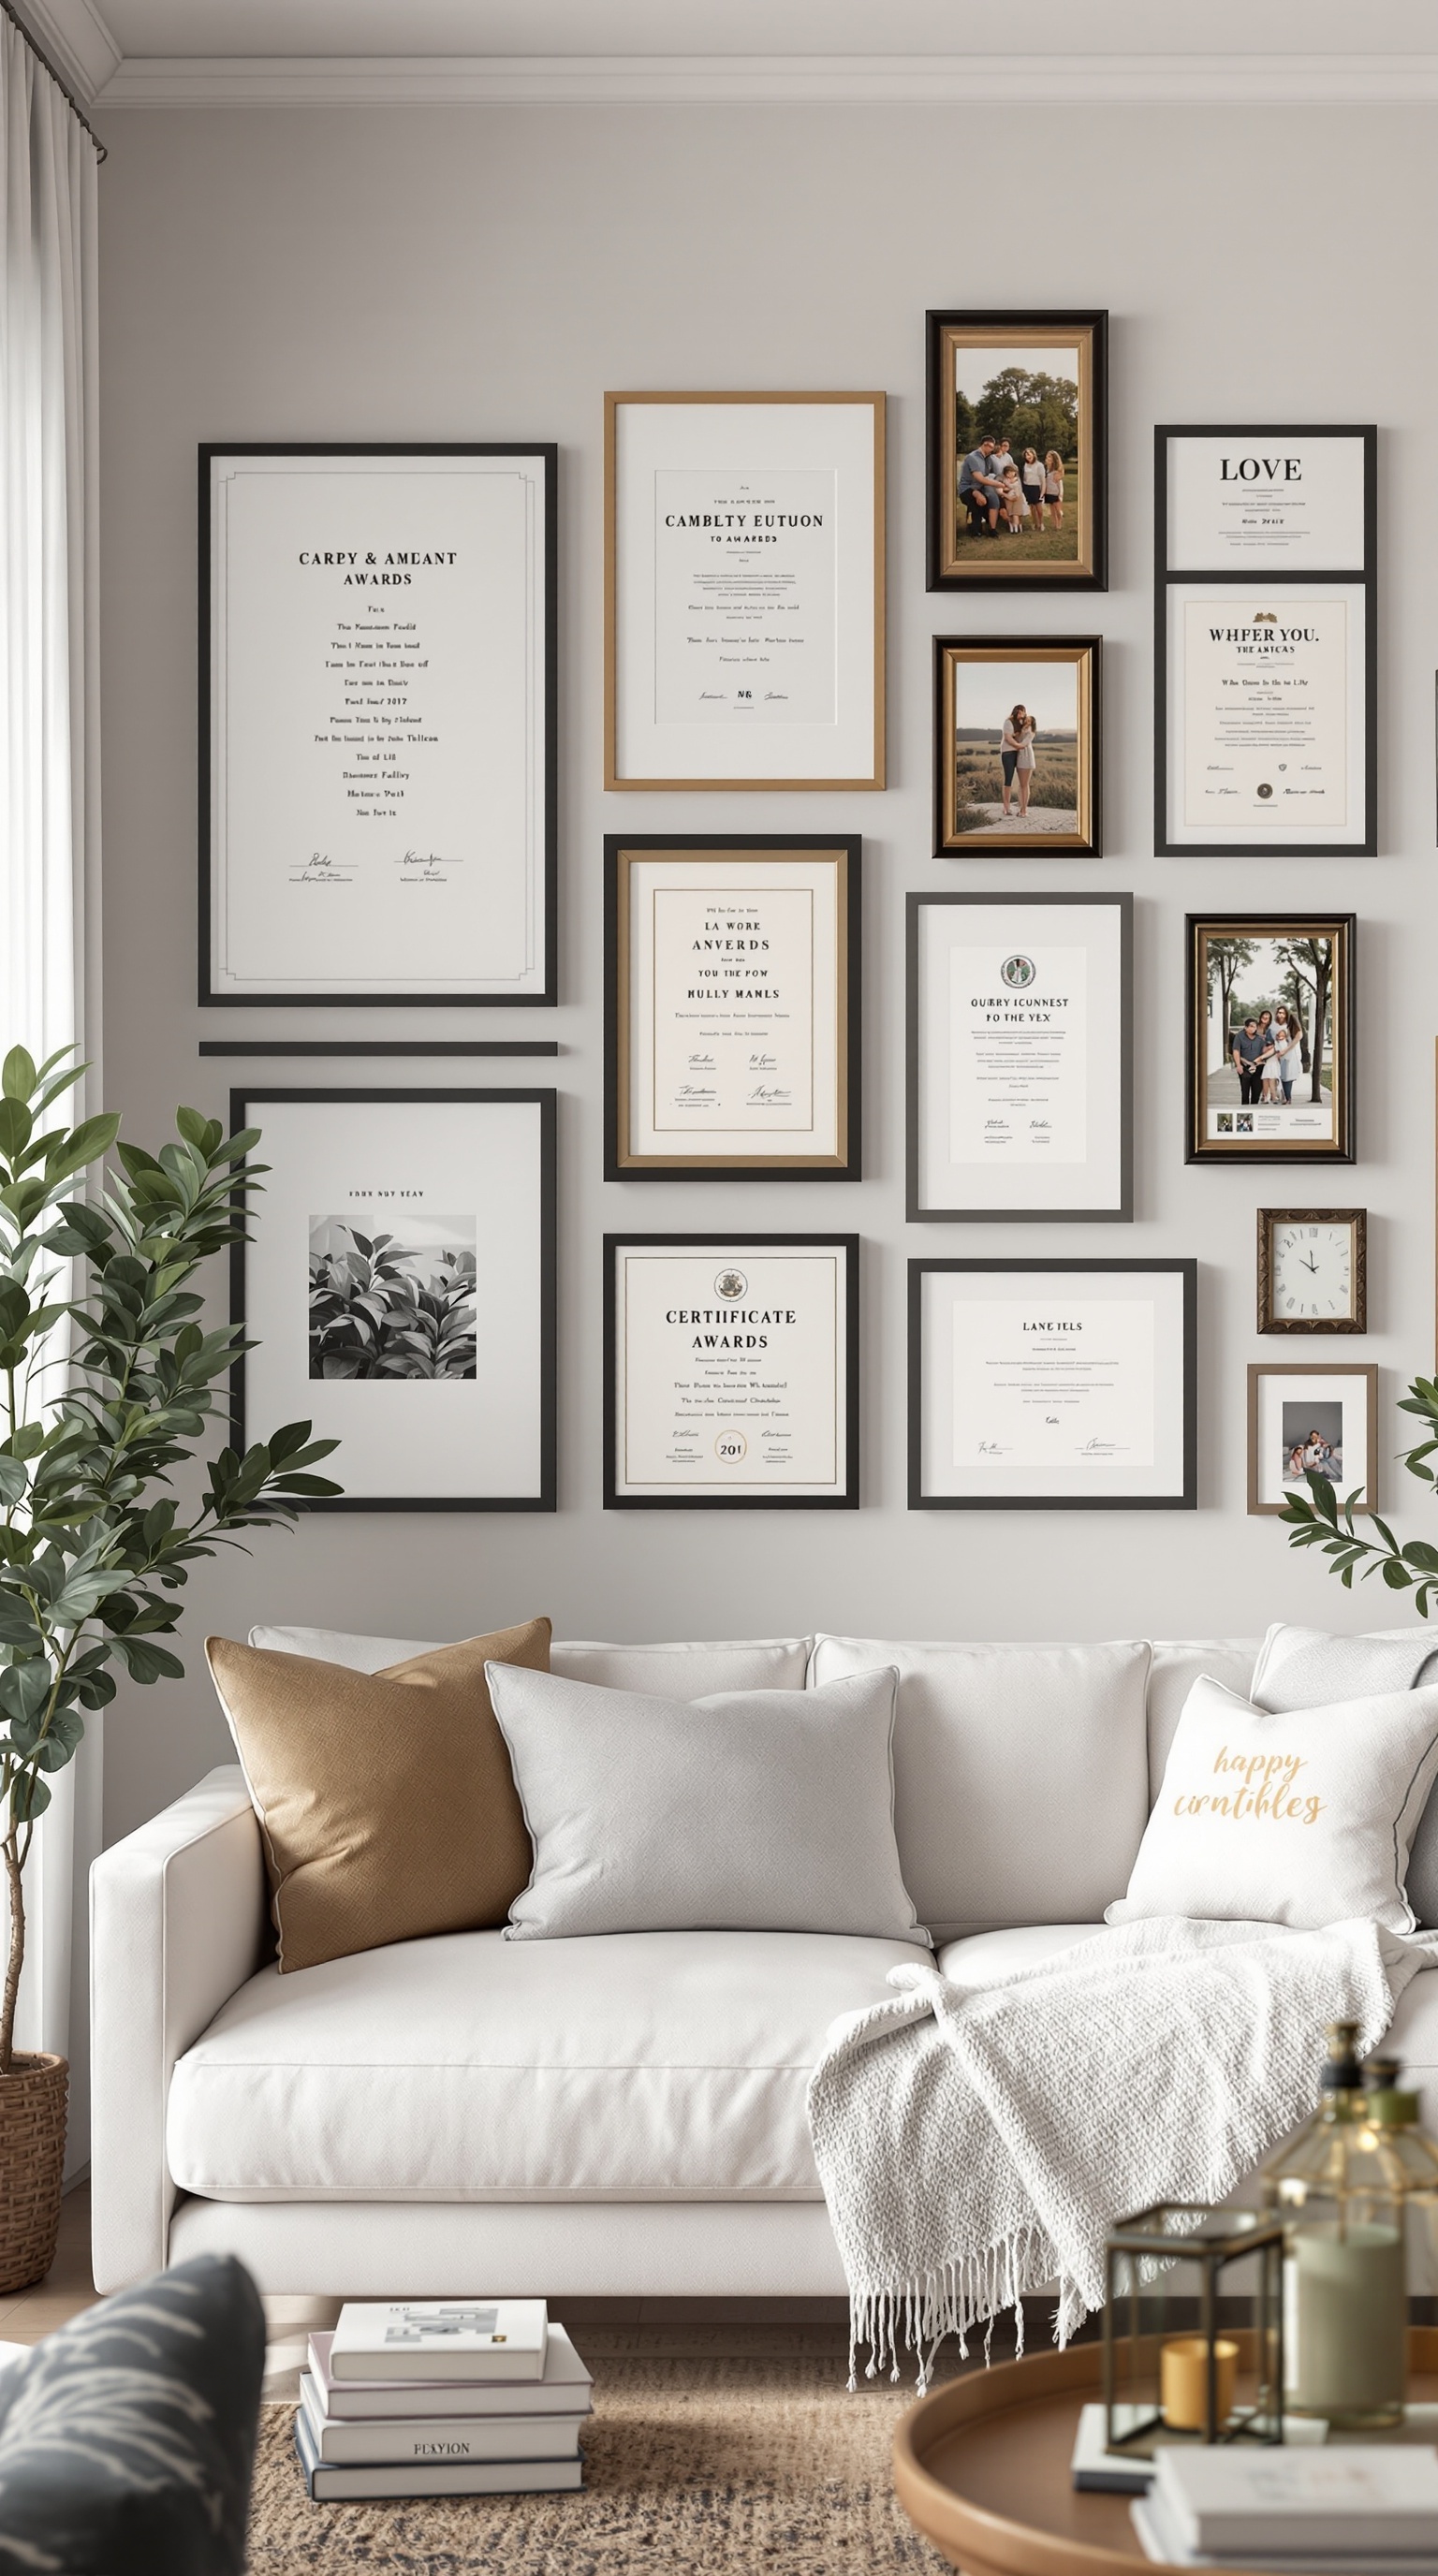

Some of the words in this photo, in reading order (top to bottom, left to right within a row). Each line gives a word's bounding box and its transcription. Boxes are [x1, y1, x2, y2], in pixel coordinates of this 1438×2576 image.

[1220, 458, 1302, 481] LOVE
[665, 514, 747, 528] CAMBLTY
[754, 514, 823, 528] EUTUON
[364, 551, 377, 565] &
[344, 573, 412, 586] AWARDS
[1279, 628, 1320, 642] YOU.
[705, 922, 720, 931] LA
[726, 922, 761, 931] WORK
[692, 939, 770, 951] ANVERDS
[666, 1310, 797, 1325] CERTIIFICATE
[692, 1335, 768, 1349] AWARDS
[1213, 1746, 1309, 1784] happy
